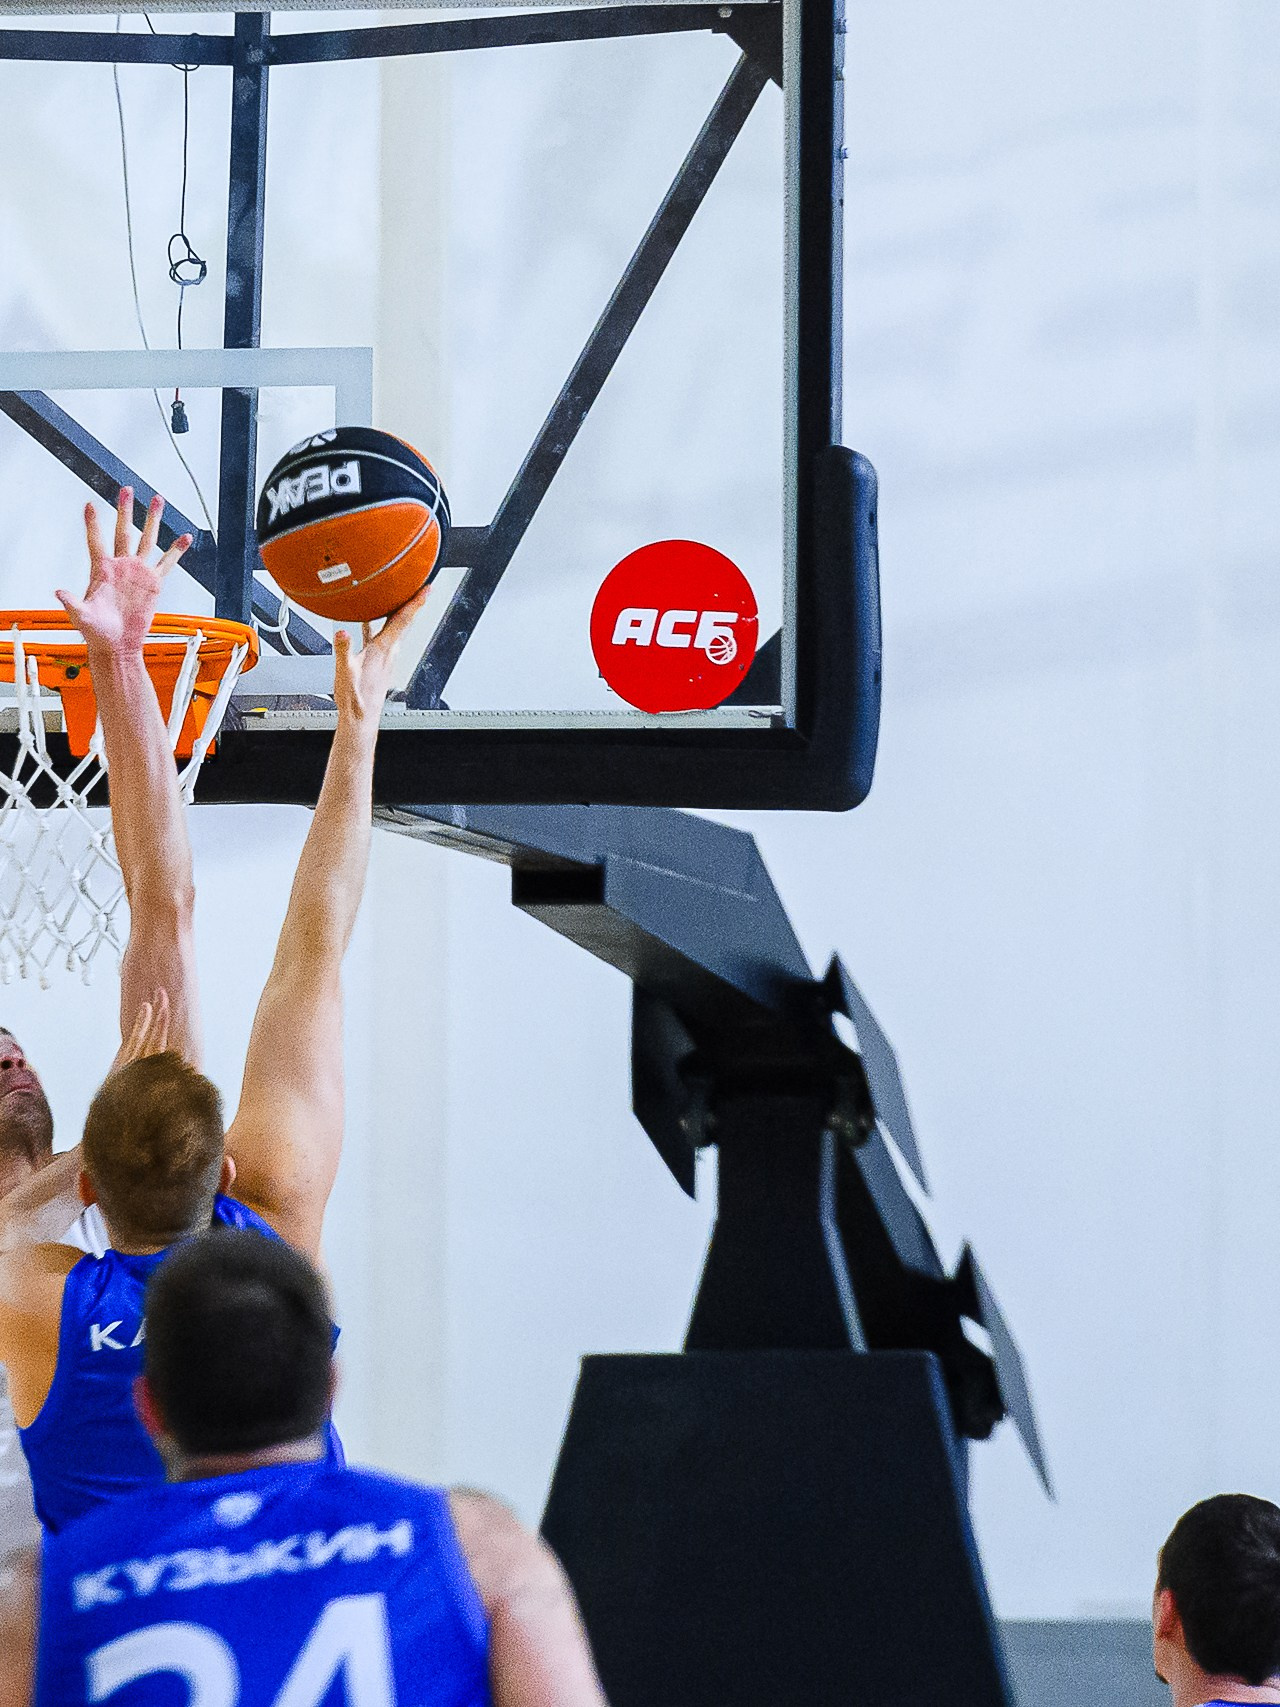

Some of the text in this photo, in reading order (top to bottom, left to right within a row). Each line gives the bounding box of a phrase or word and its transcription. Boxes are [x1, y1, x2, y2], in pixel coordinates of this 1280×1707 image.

[266, 460, 361, 525] PEAK
[611, 607, 738, 652] АСБ
[72, 1519, 414, 1611] КУЗЬКИН
